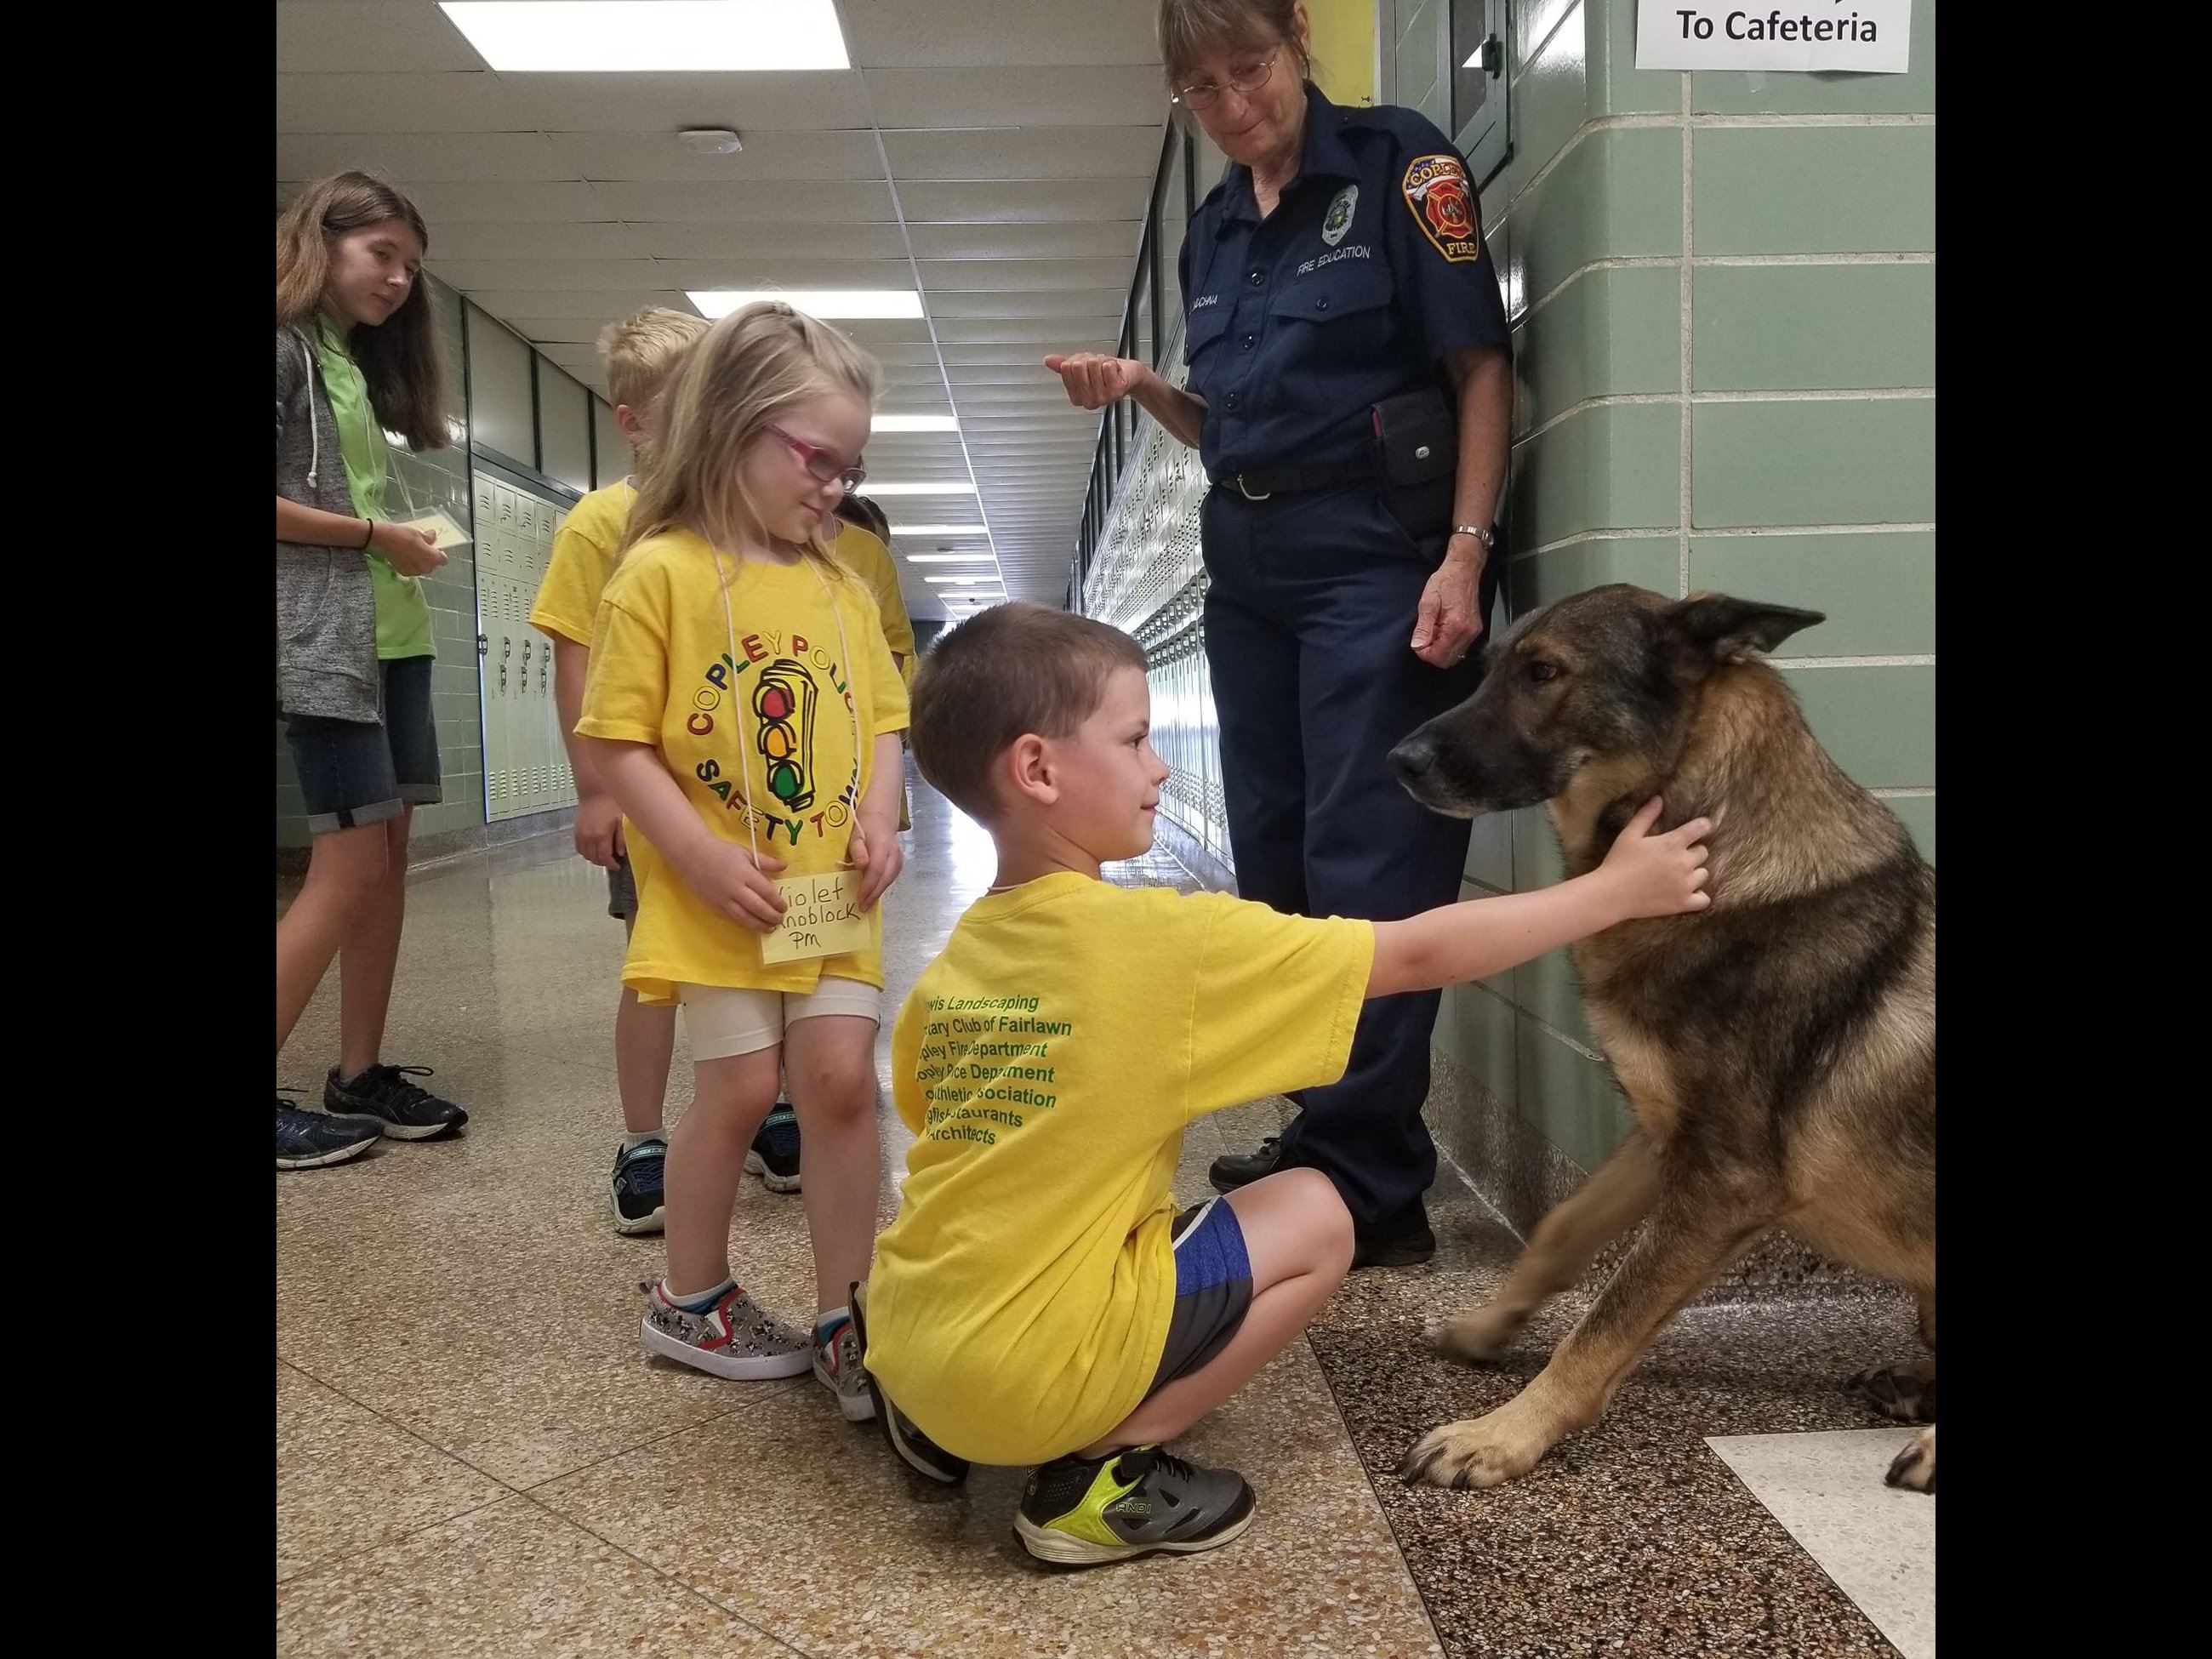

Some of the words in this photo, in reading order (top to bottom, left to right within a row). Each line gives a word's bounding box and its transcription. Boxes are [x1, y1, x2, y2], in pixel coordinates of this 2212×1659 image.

[1676, 9, 1713, 39] To
[1725, 9, 1878, 43] Cafeteria
[1297, 259, 1315, 276] FIRE
[1317, 245, 1371, 269] EDUCATION
[1446, 242, 1476, 255] FIRE
[687, 630, 782, 736] COPLEY
[696, 759, 804, 847] SAFETY
[947, 994, 1040, 1013] Landscaping
[925, 1022, 949, 1037] tary
[952, 1018, 982, 1034] Club
[983, 1016, 996, 1032] of
[998, 1016, 1072, 1036] Fairlawn
[919, 1044, 947, 1062] pley
[948, 1040, 968, 1057] Fire
